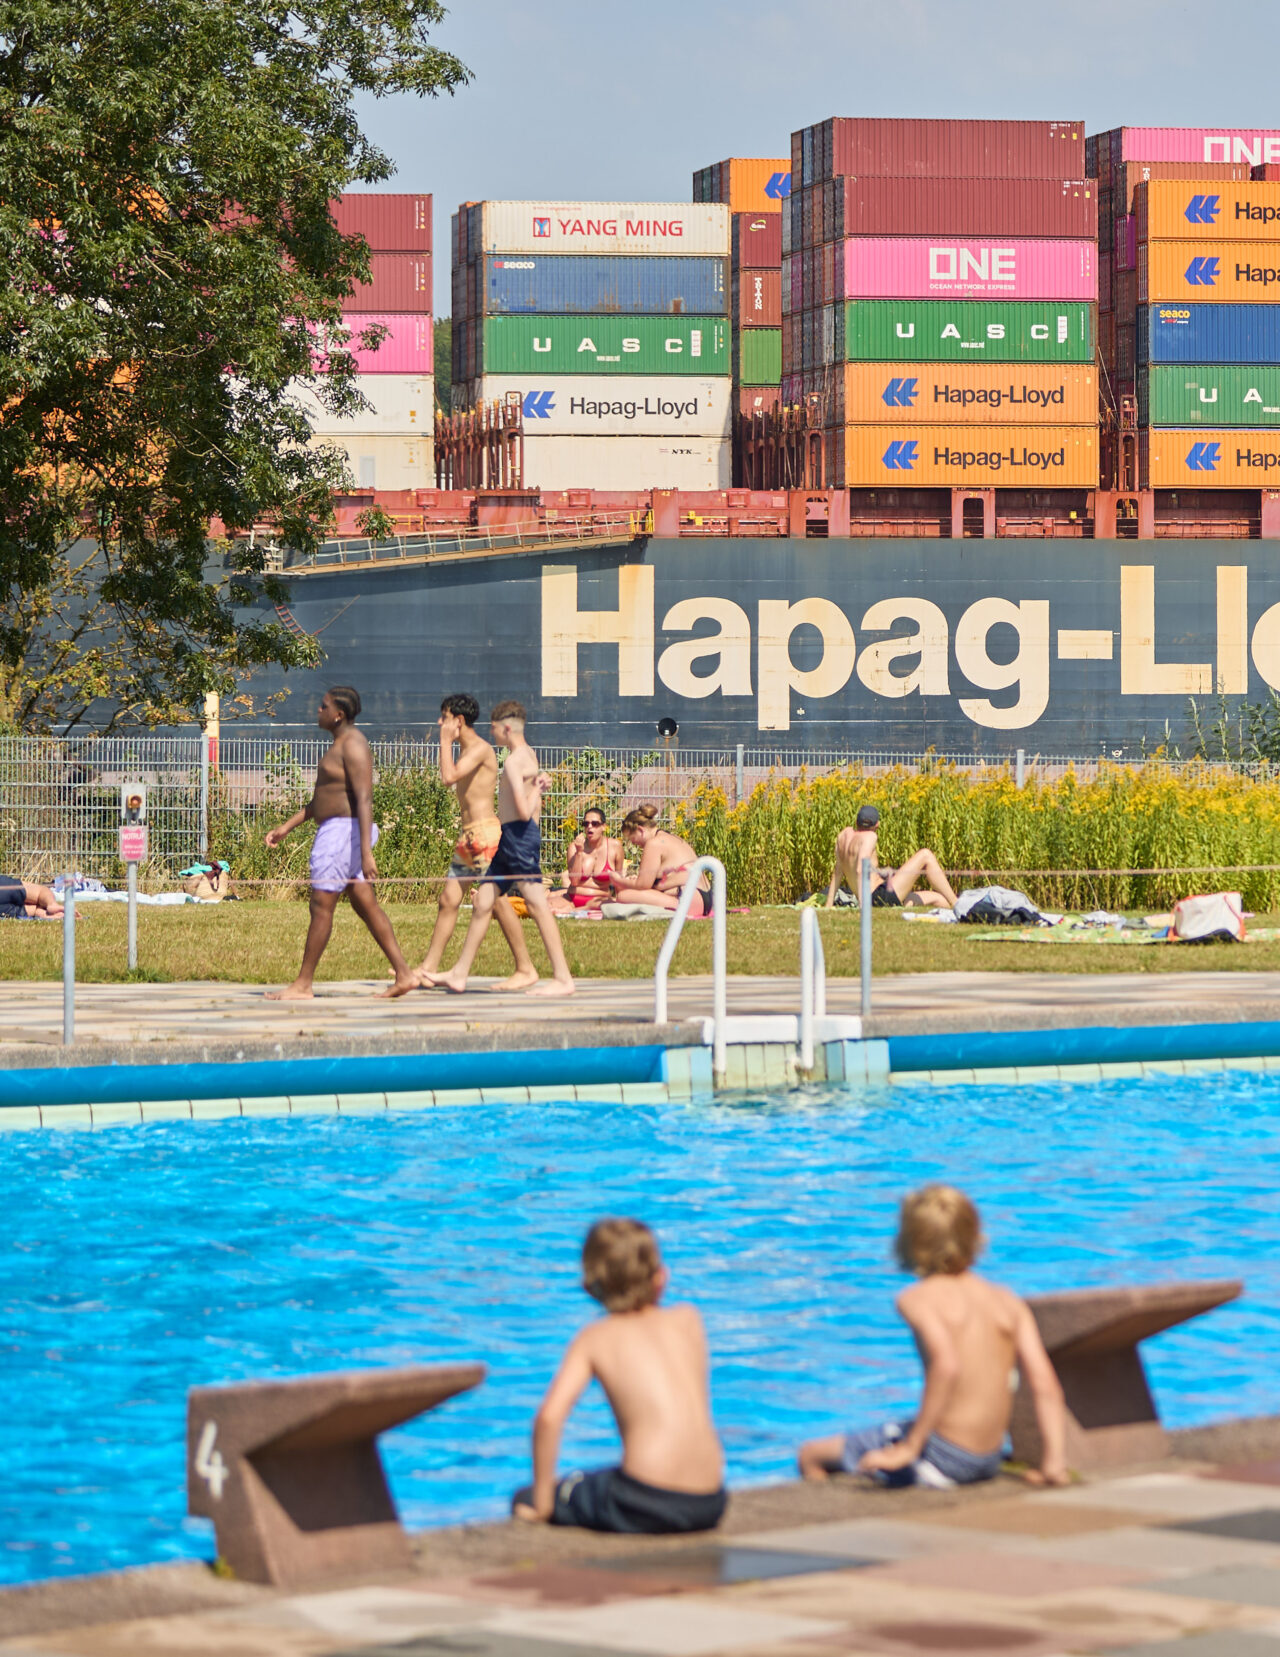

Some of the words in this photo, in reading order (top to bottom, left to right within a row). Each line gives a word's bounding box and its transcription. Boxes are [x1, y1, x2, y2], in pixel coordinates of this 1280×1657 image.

[557, 219, 617, 236] YANG
[625, 220, 683, 237] MING
[929, 247, 1016, 281] ONE
[754, 277, 762, 310] TRITON
[1159, 309, 1191, 319] seaco
[570, 396, 698, 419] Hapag-Lloyd
[934, 384, 1065, 408] Hapag-Lloyd
[934, 447, 1065, 470] Hapag-Lloyd
[195, 1419, 230, 1500] 4
